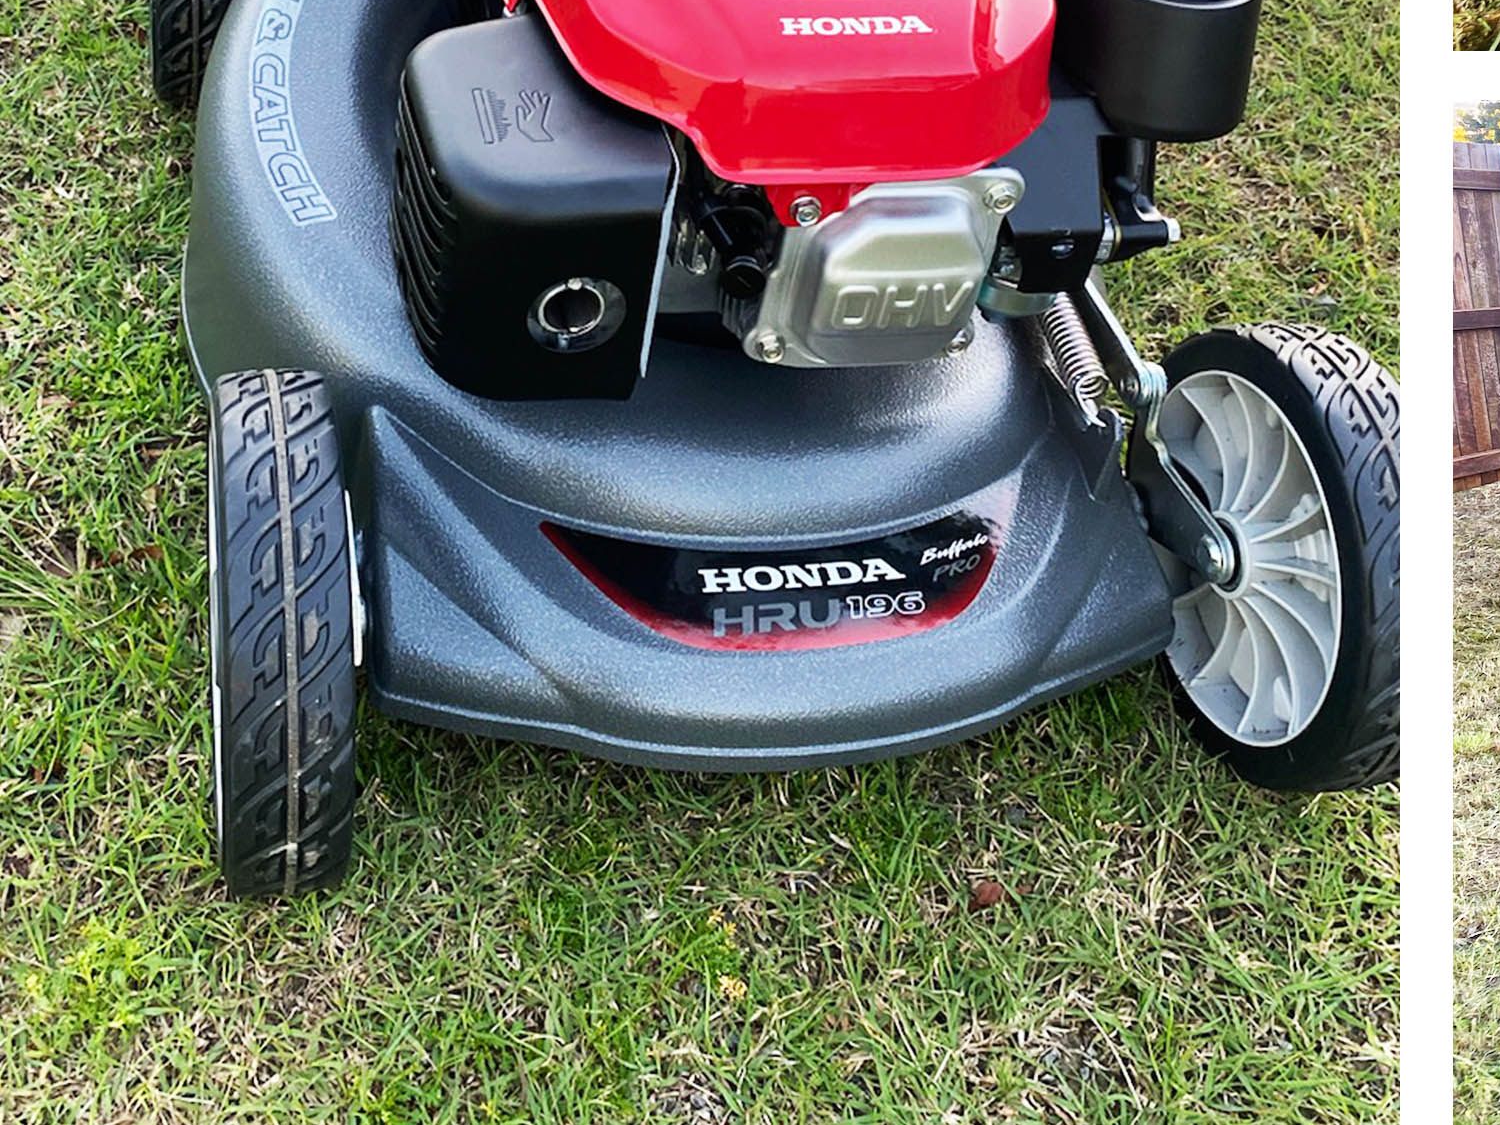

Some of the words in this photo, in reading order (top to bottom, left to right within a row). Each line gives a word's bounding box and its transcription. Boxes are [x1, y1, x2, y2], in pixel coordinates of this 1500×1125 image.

[257, 9, 293, 44] &
[780, 16, 933, 36] HONDA
[253, 55, 332, 223] CATCH
[832, 280, 975, 329] OHV
[920, 533, 990, 566] Buffalo
[698, 558, 906, 594] HONDA
[933, 553, 981, 582] PRO
